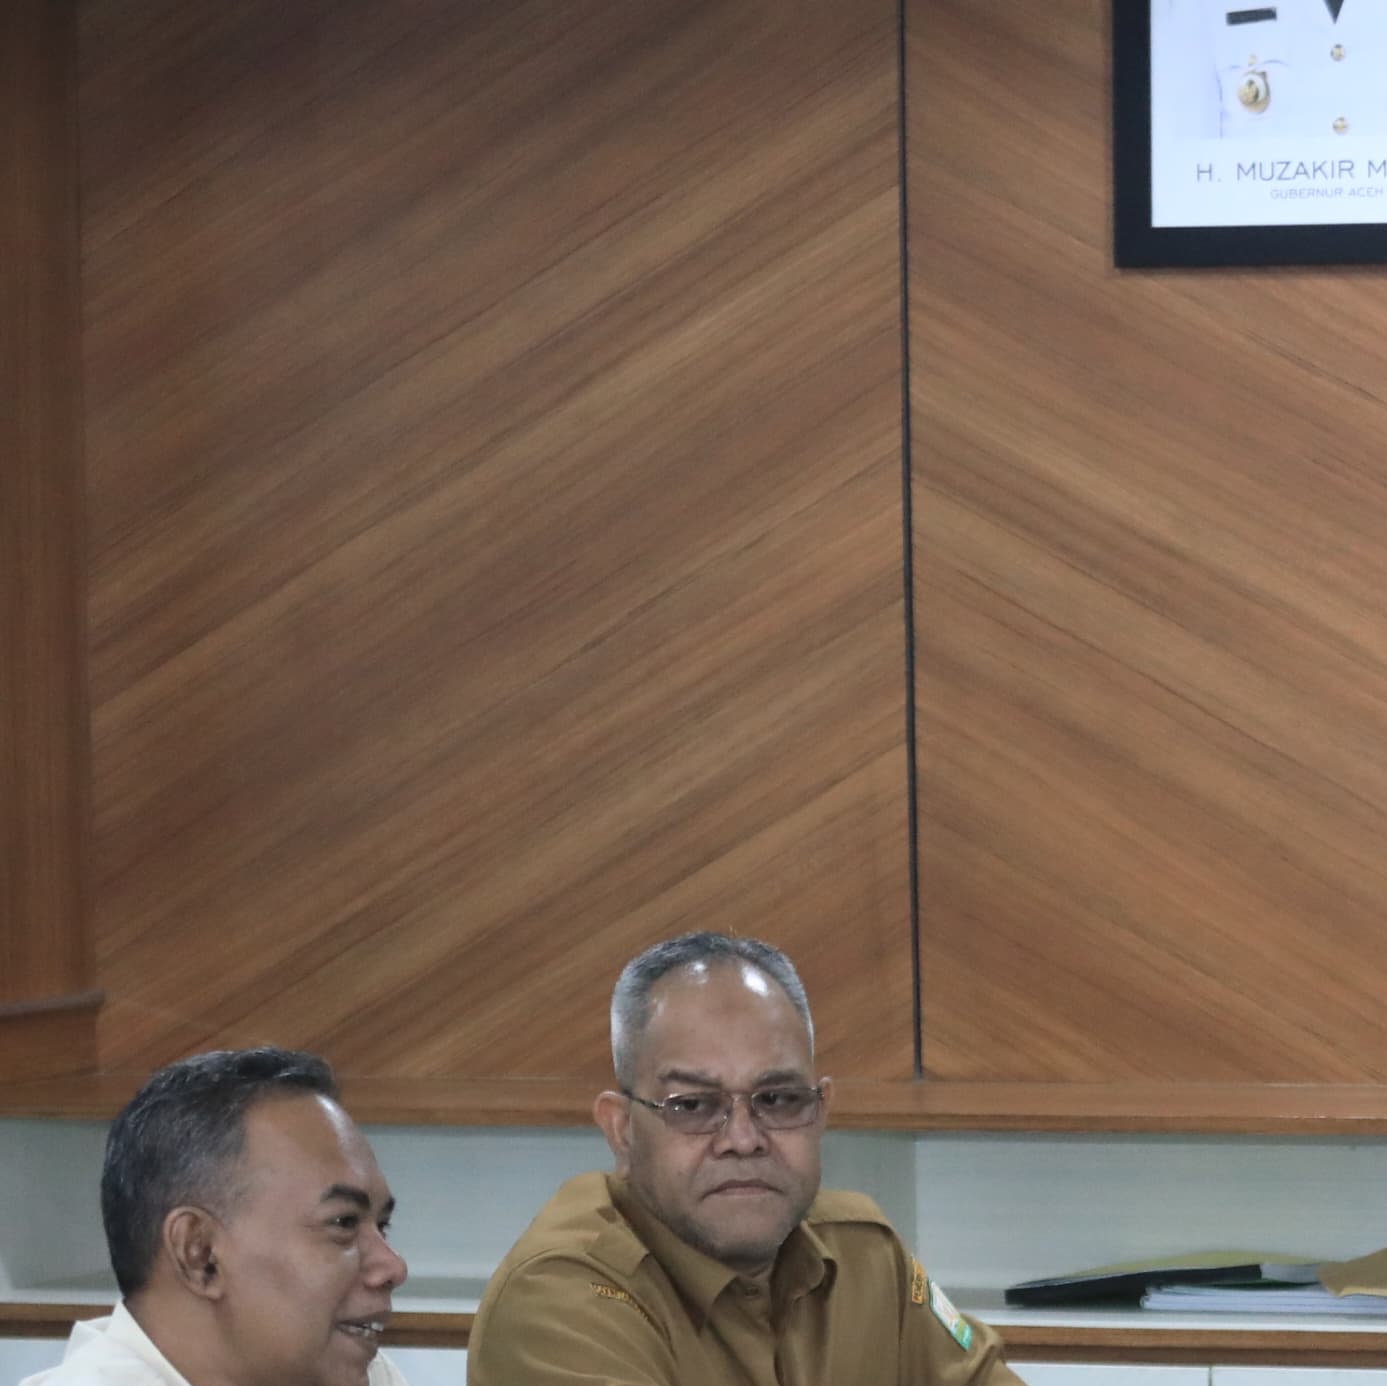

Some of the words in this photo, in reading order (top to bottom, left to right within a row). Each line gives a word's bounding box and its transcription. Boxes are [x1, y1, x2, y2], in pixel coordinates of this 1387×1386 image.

[1195, 162, 1222, 183] H.
[1236, 159, 1355, 182] MUZAKIR
[1270, 186, 1344, 200] GUBERNUR
[1348, 185, 1384, 198] ACEH
